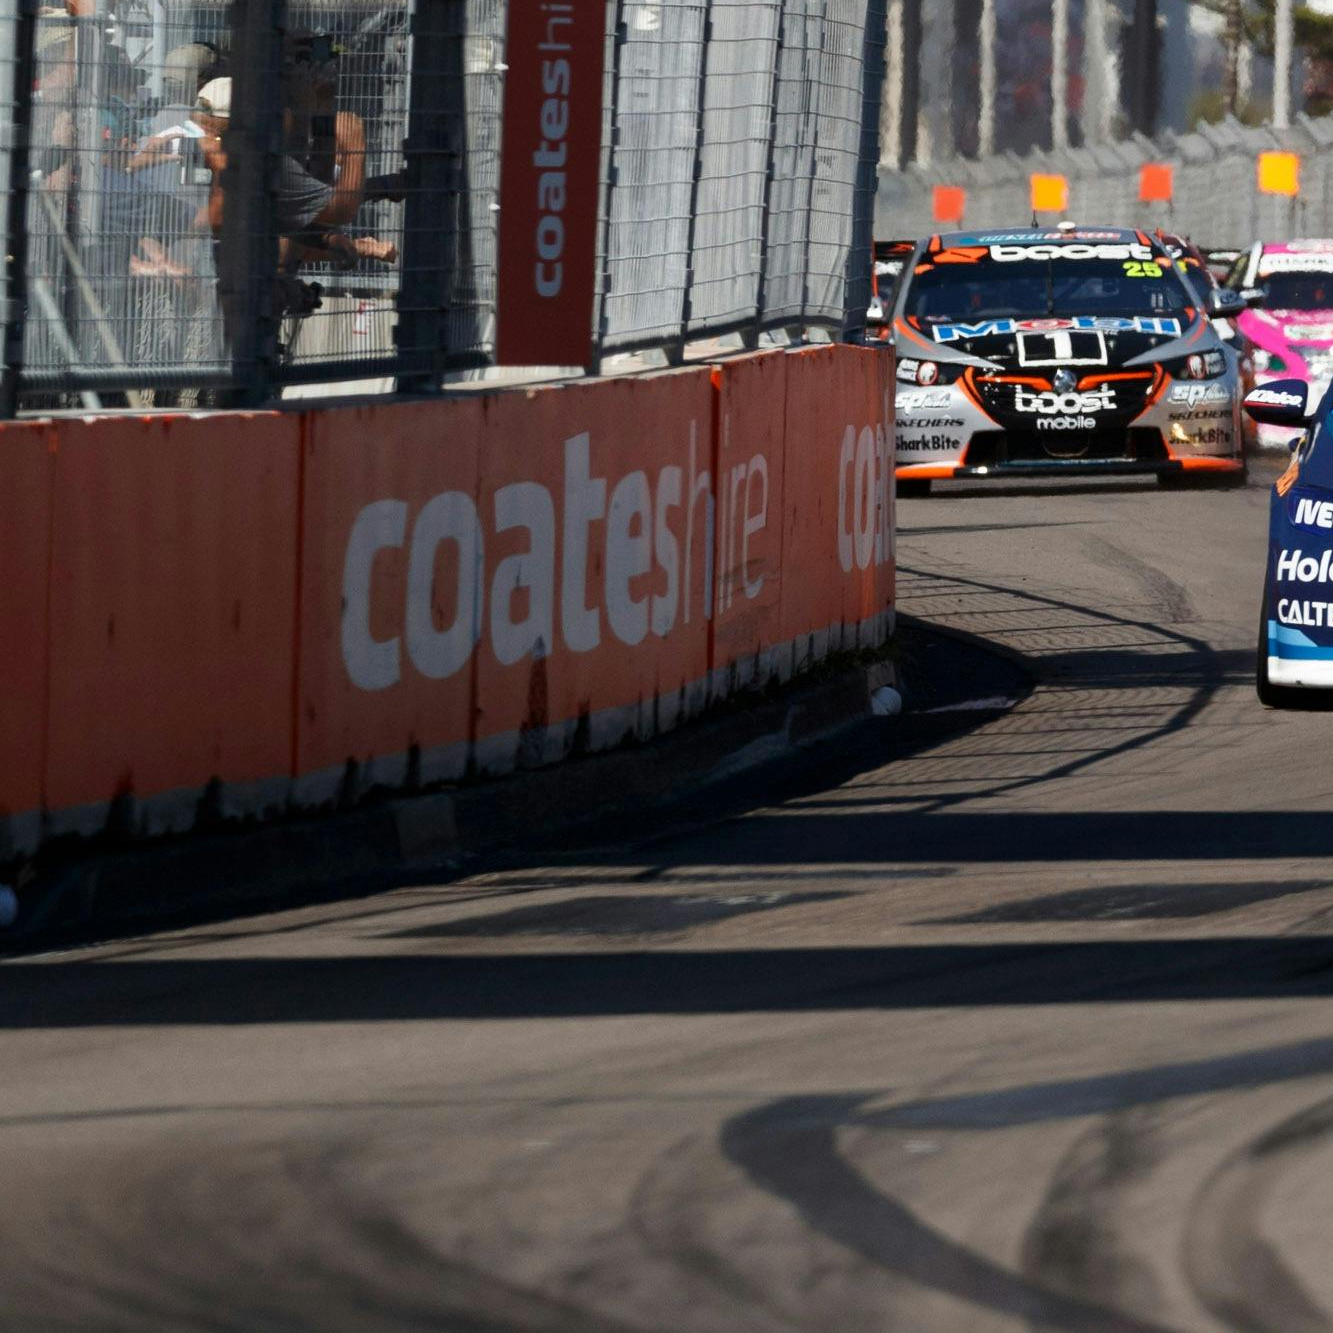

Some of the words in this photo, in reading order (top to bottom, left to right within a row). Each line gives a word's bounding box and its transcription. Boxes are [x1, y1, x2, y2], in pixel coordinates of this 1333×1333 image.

[990, 242, 1152, 262] boost
[1122, 261, 1163, 277] 25
[1015, 382, 1117, 414] boost
[1036, 415, 1096, 430] mobile
